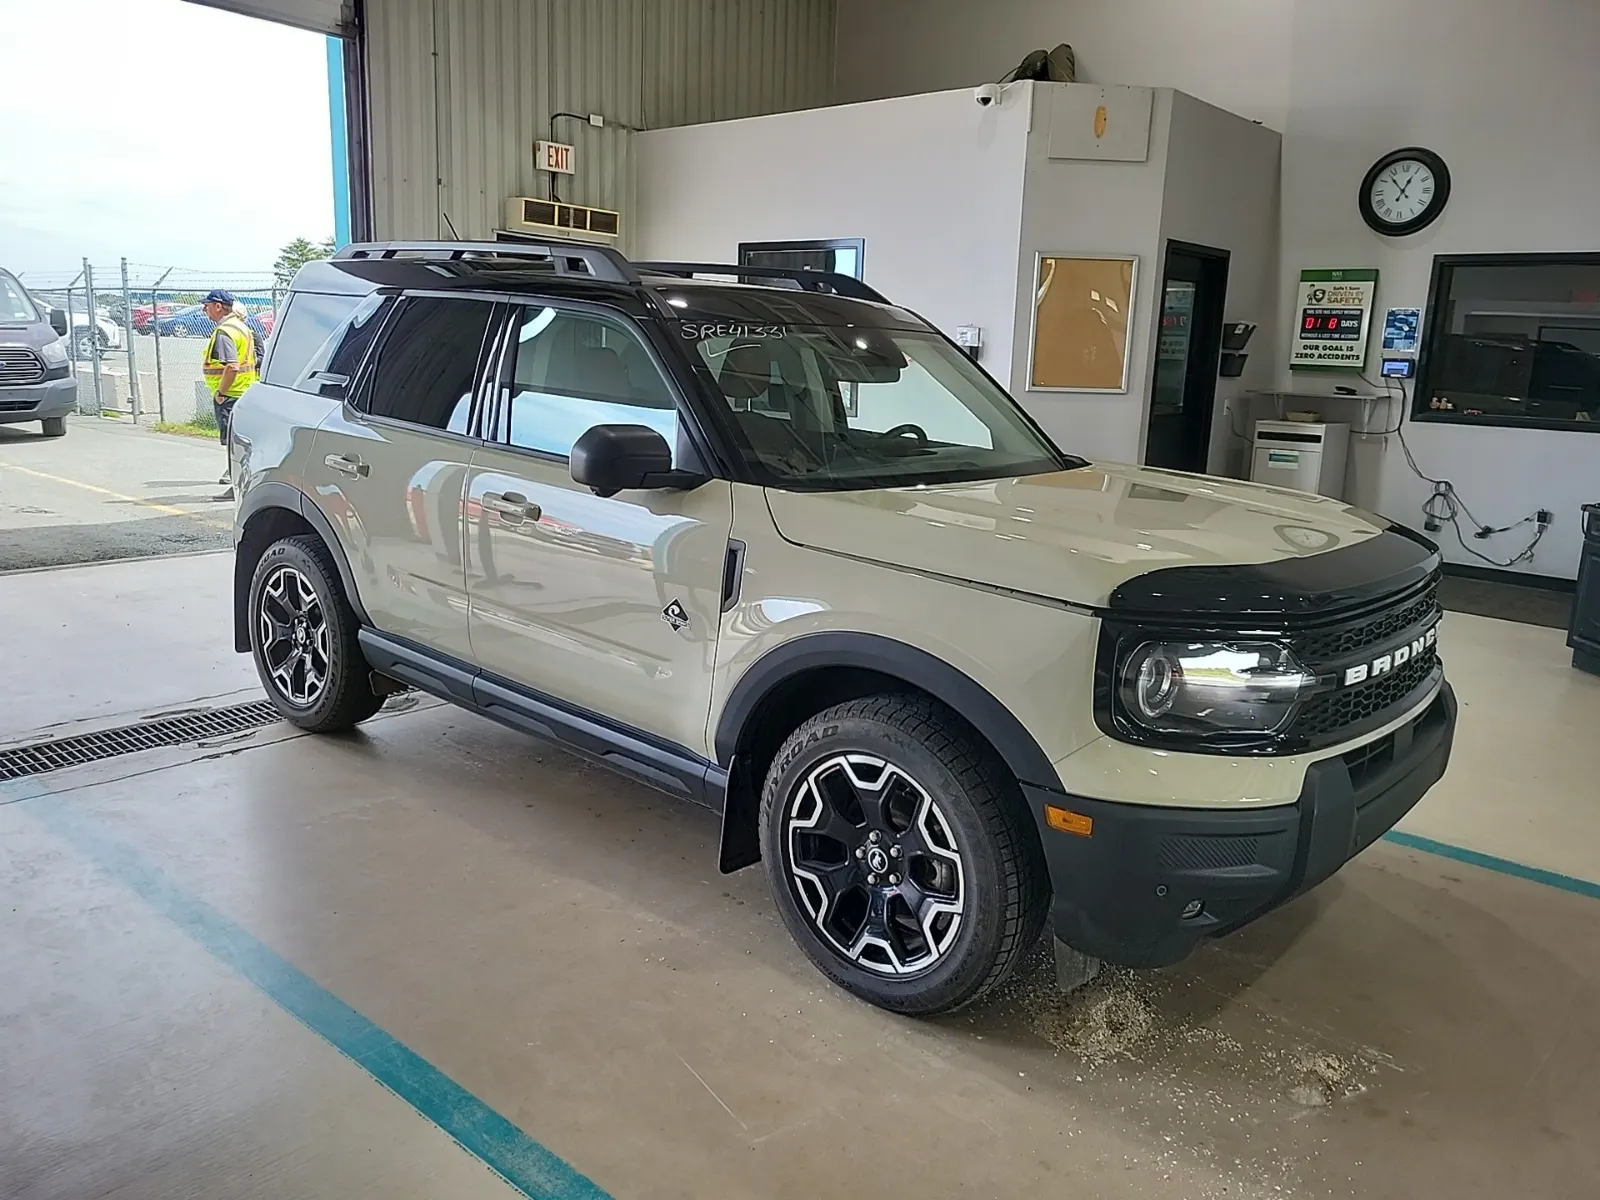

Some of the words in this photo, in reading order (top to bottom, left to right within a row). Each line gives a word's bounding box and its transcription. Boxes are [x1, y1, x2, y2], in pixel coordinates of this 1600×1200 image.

[547, 145, 570, 170] EXIT
[680, 324, 788, 339] SRE41331
[1322, 344, 1344, 352] GOAL
